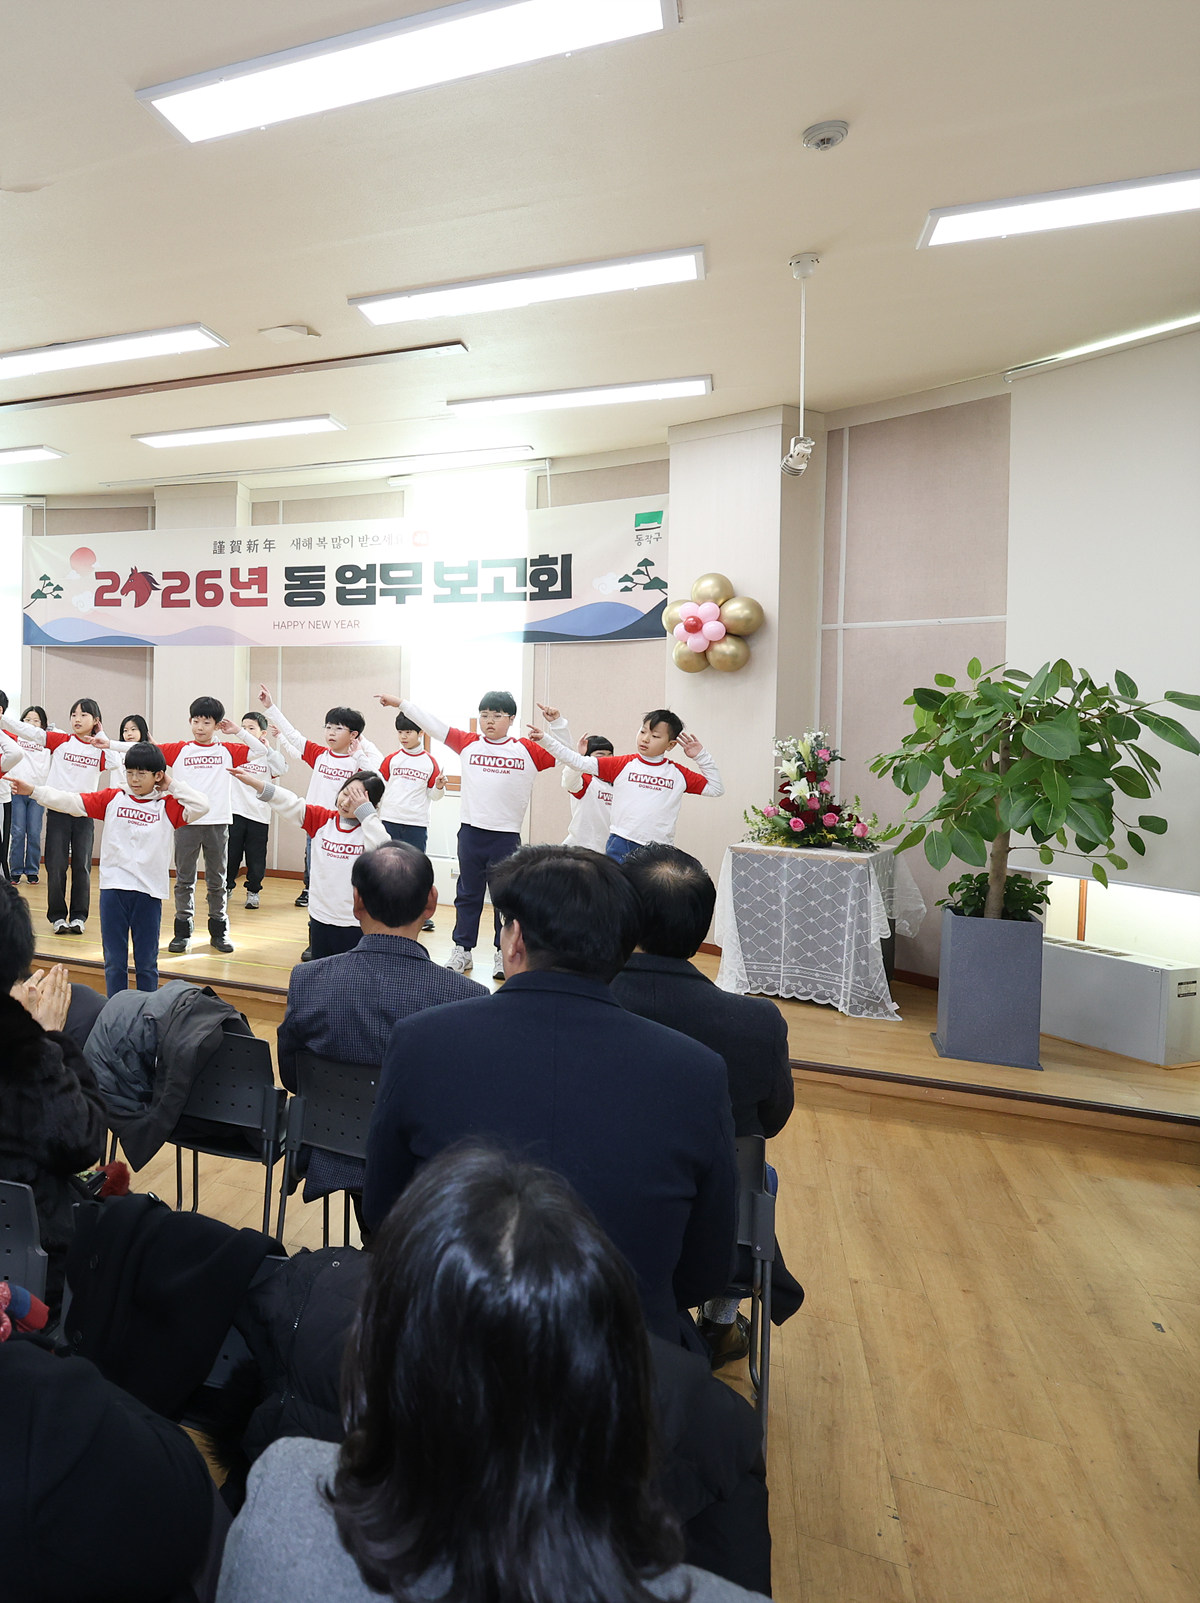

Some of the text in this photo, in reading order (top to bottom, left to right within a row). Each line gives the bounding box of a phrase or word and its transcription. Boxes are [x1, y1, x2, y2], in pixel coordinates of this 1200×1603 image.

[212, 538, 277, 555] 謹賀新年
[290, 538, 314, 551] 새해
[316, 536, 328, 550] 복
[331, 535, 355, 549] 많이
[634, 532, 663, 547] 동작구
[284, 565, 326, 608] 동
[335, 561, 423, 606] 업무
[433, 553, 573, 604] 보고회
[272, 619, 361, 630] HAPPY NEW YEAR
[63, 753, 99, 767] KIWOOM
[184, 756, 222, 766] KIWOOM
[469, 754, 525, 771] KIWOOM
[393, 768, 429, 781] KIWOOM
[483, 767, 511, 775] DONGJAK
[628, 773, 674, 789] KIWOOM
[321, 838, 365, 855] KIWOOM
[327, 852, 349, 860] DONGJAK
